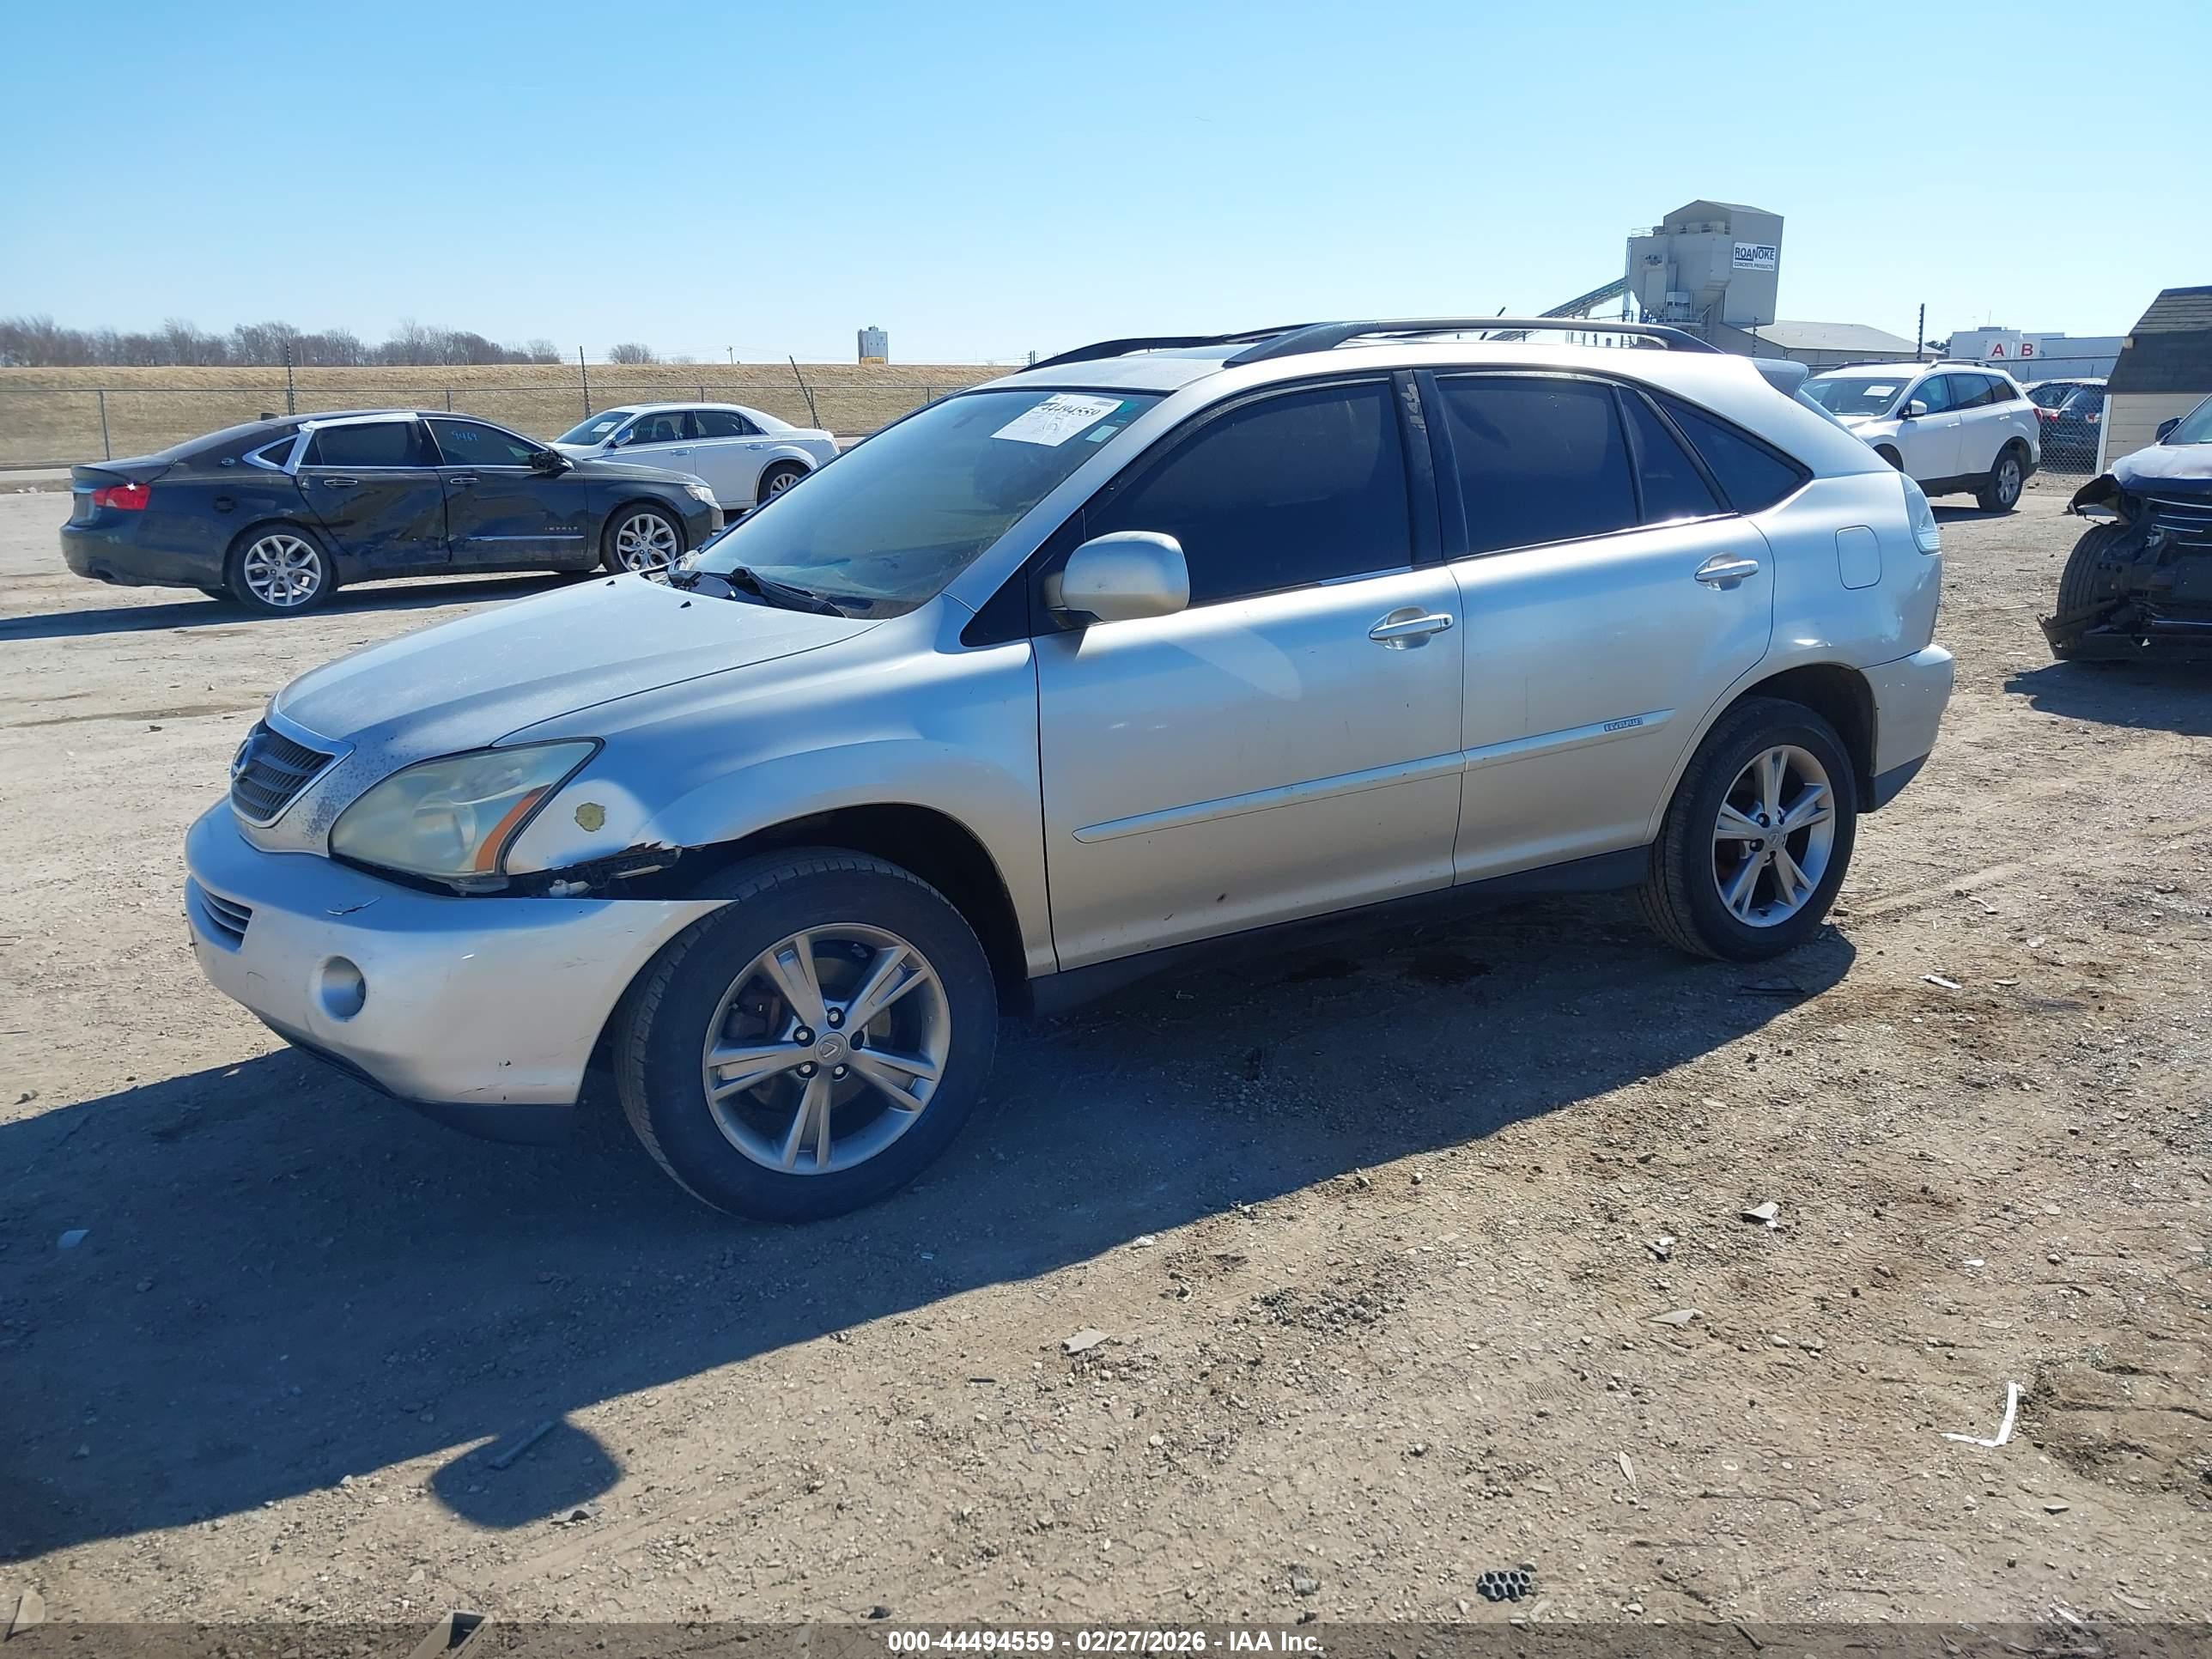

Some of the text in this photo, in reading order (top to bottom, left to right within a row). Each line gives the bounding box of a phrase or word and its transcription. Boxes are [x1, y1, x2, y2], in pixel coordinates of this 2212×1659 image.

[1735, 246, 1775, 260] ROANOKE
[1991, 343, 2033, 356] A B
